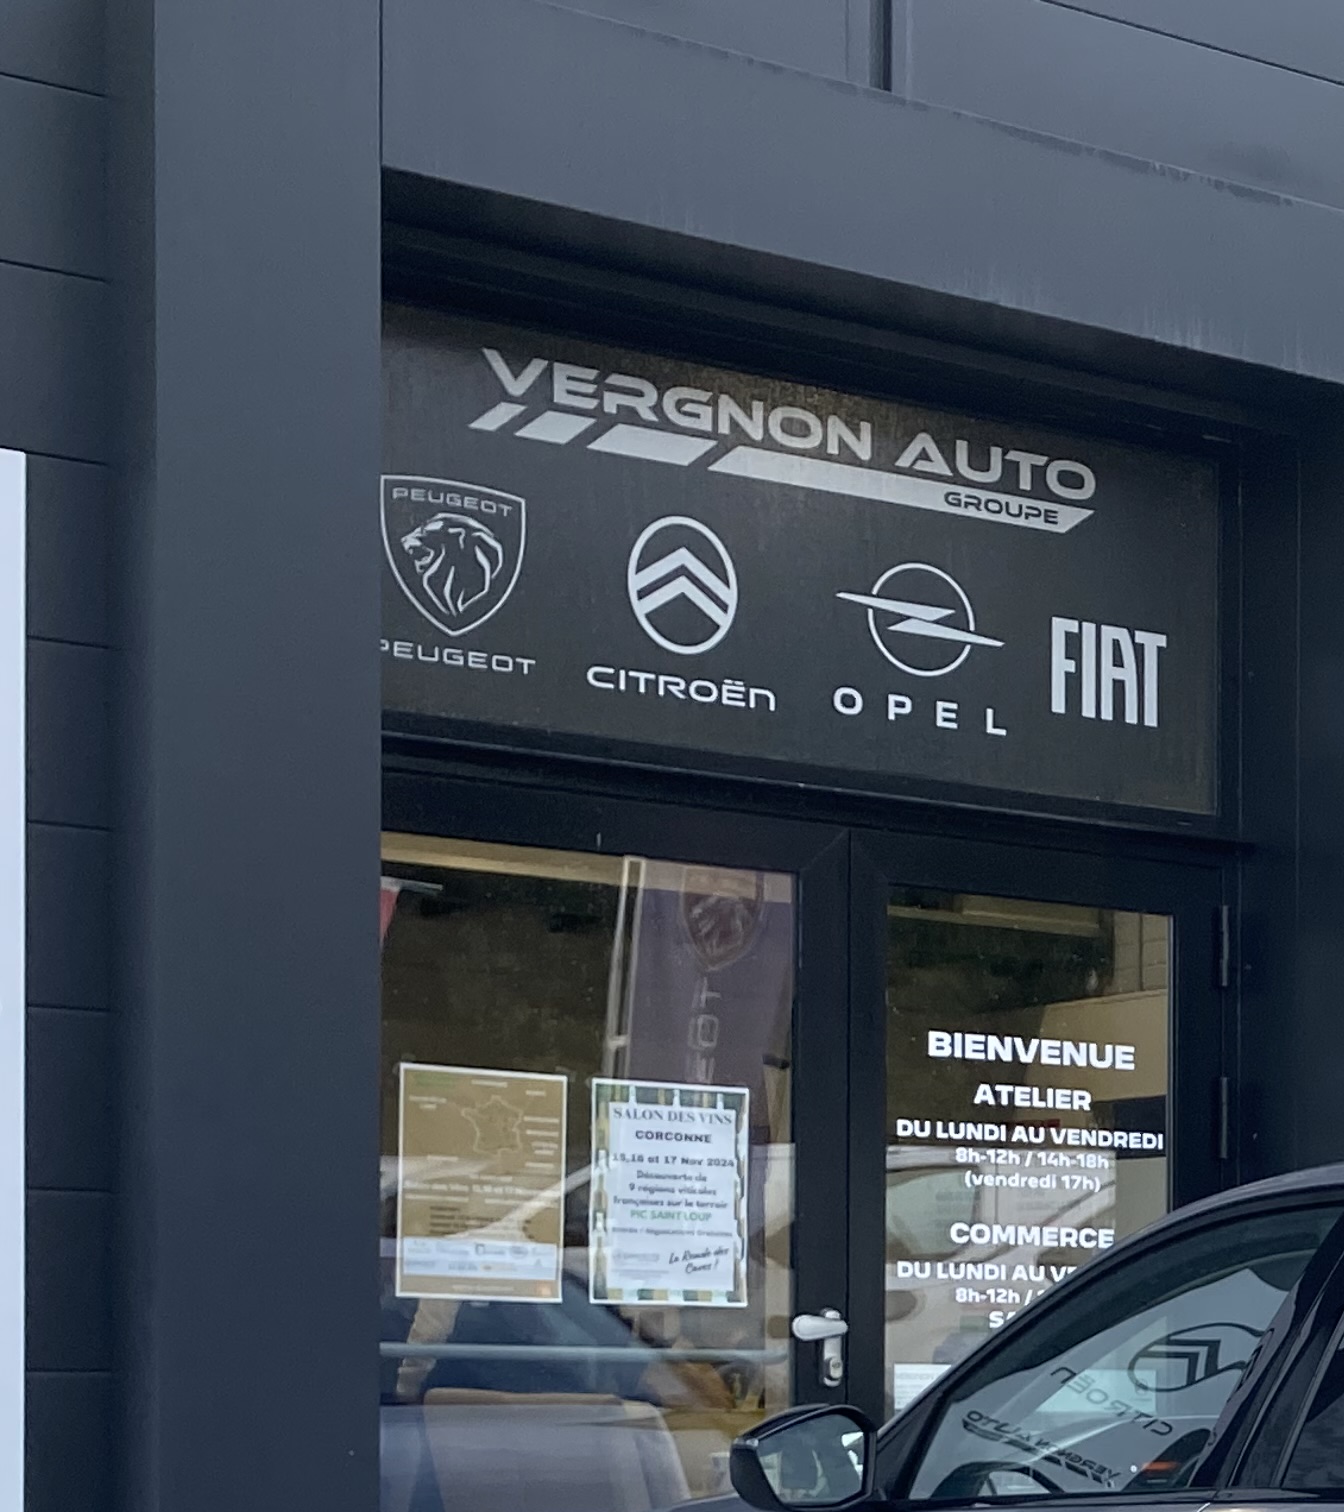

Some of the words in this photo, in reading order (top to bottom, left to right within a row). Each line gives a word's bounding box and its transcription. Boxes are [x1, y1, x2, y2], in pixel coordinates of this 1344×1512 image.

[481, 347, 873, 461] VERGNON
[895, 432, 1096, 500] AUTO
[392, 487, 513, 517] PEUGEOT
[943, 491, 1060, 525] GROUPE
[1050, 615, 1167, 728] FIAT
[586, 665, 776, 712] CITROËN
[832, 685, 1007, 736] OPEL
[927, 1029, 1135, 1071] BIENVENUE
[973, 1083, 1092, 1111] ATELIER
[613, 1108, 664, 1120] SALON
[668, 1110, 695, 1121] DES
[699, 1112, 732, 1125] VINS
[635, 1130, 712, 1143] CORCONNE
[896, 1119, 931, 1138] DU
[936, 1121, 1007, 1142] LUNDI
[1011, 1125, 1045, 1144] AU
[1049, 1127, 1164, 1150] VENDREDI
[664, 1155, 677, 1164] 17
[707, 1158, 734, 1167] 2024
[955, 1147, 1021, 1166] 8h-12h
[1024, 1148, 1033, 1168] /
[1037, 1151, 1109, 1169] 14h-18h
[964, 1170, 1056, 1190] (vendredi
[1061, 1174, 1101, 1193] 17h)
[950, 1222, 1115, 1249] COMMERCE
[896, 1260, 931, 1278] DU
[936, 1262, 1007, 1281] LUNDI
[1011, 1264, 1045, 1282] AU
[955, 1287, 1021, 1305] 8h-12h
